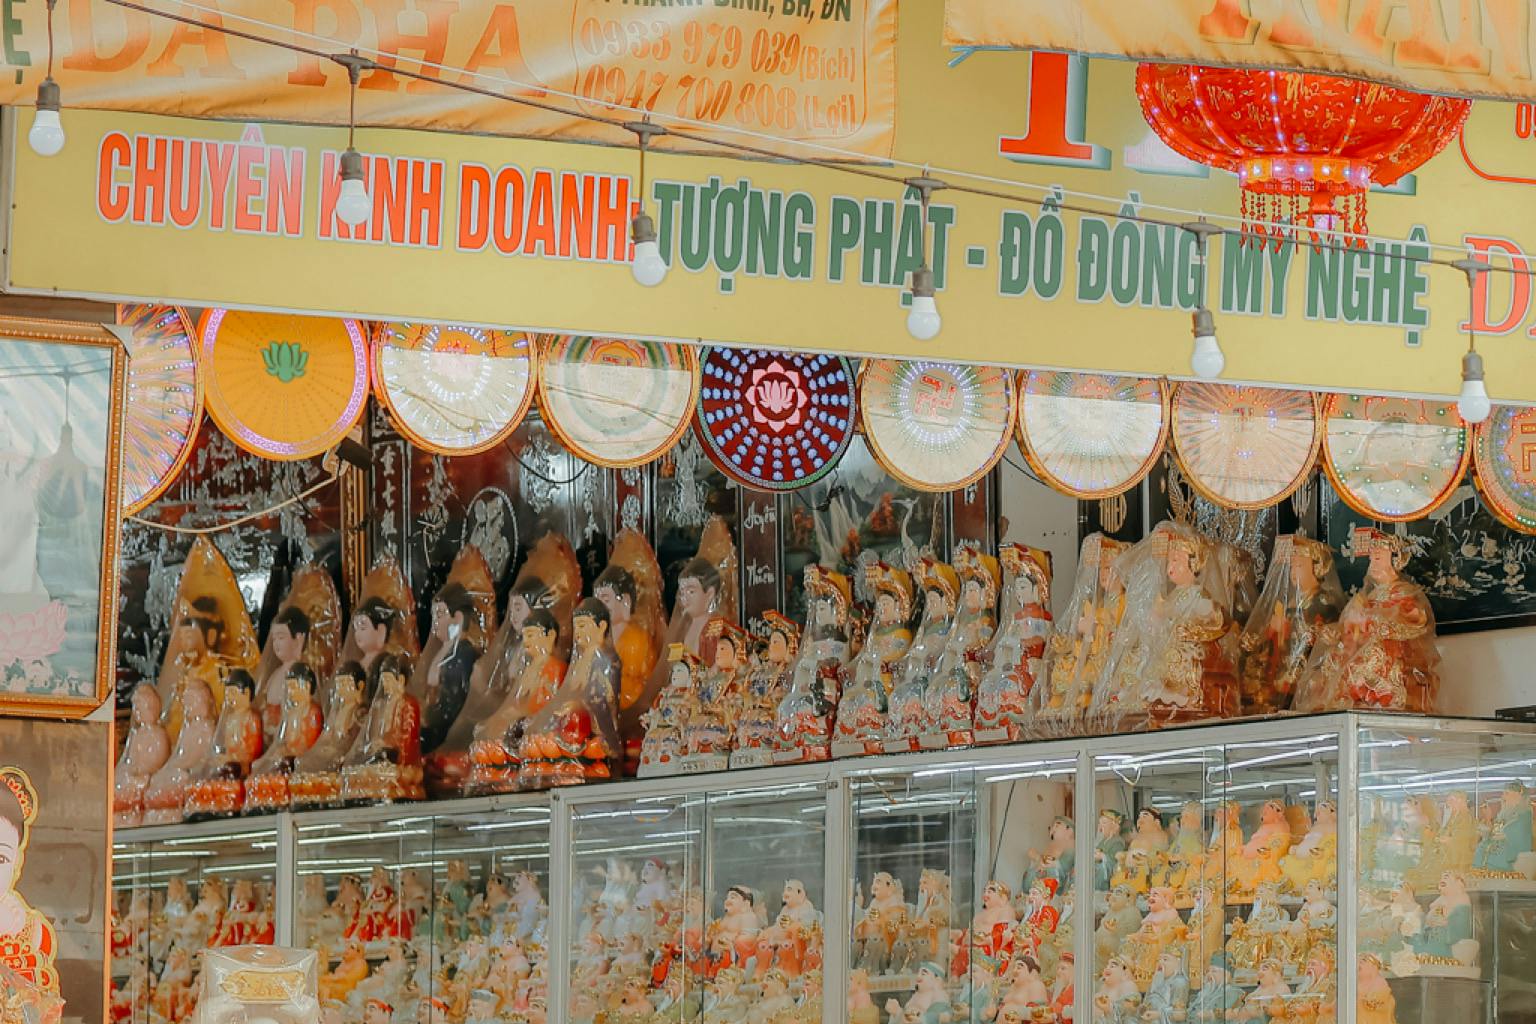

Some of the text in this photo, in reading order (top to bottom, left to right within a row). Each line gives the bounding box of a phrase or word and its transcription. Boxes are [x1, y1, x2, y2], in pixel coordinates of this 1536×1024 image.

[62, 0, 247, 80] DA
[287, 0, 547, 98] PHA
[582, 17, 672, 59] 0933
[683, 20, 743, 70] 979
[751, 27, 799, 76] 039
[677, 74, 734, 121] 700
[734, 81, 798, 130] 808
[98, 125, 306, 236] CHUYÊN
[319, 150, 445, 248] KNH
[653, 177, 813, 291] TƯỢNG
[830, 187, 953, 308] PHẬT
[1002, 184, 1065, 302] ĐỒ
[1077, 192, 1203, 309] ĐỒNG
[1306, 227, 1430, 345] NGHỆ
